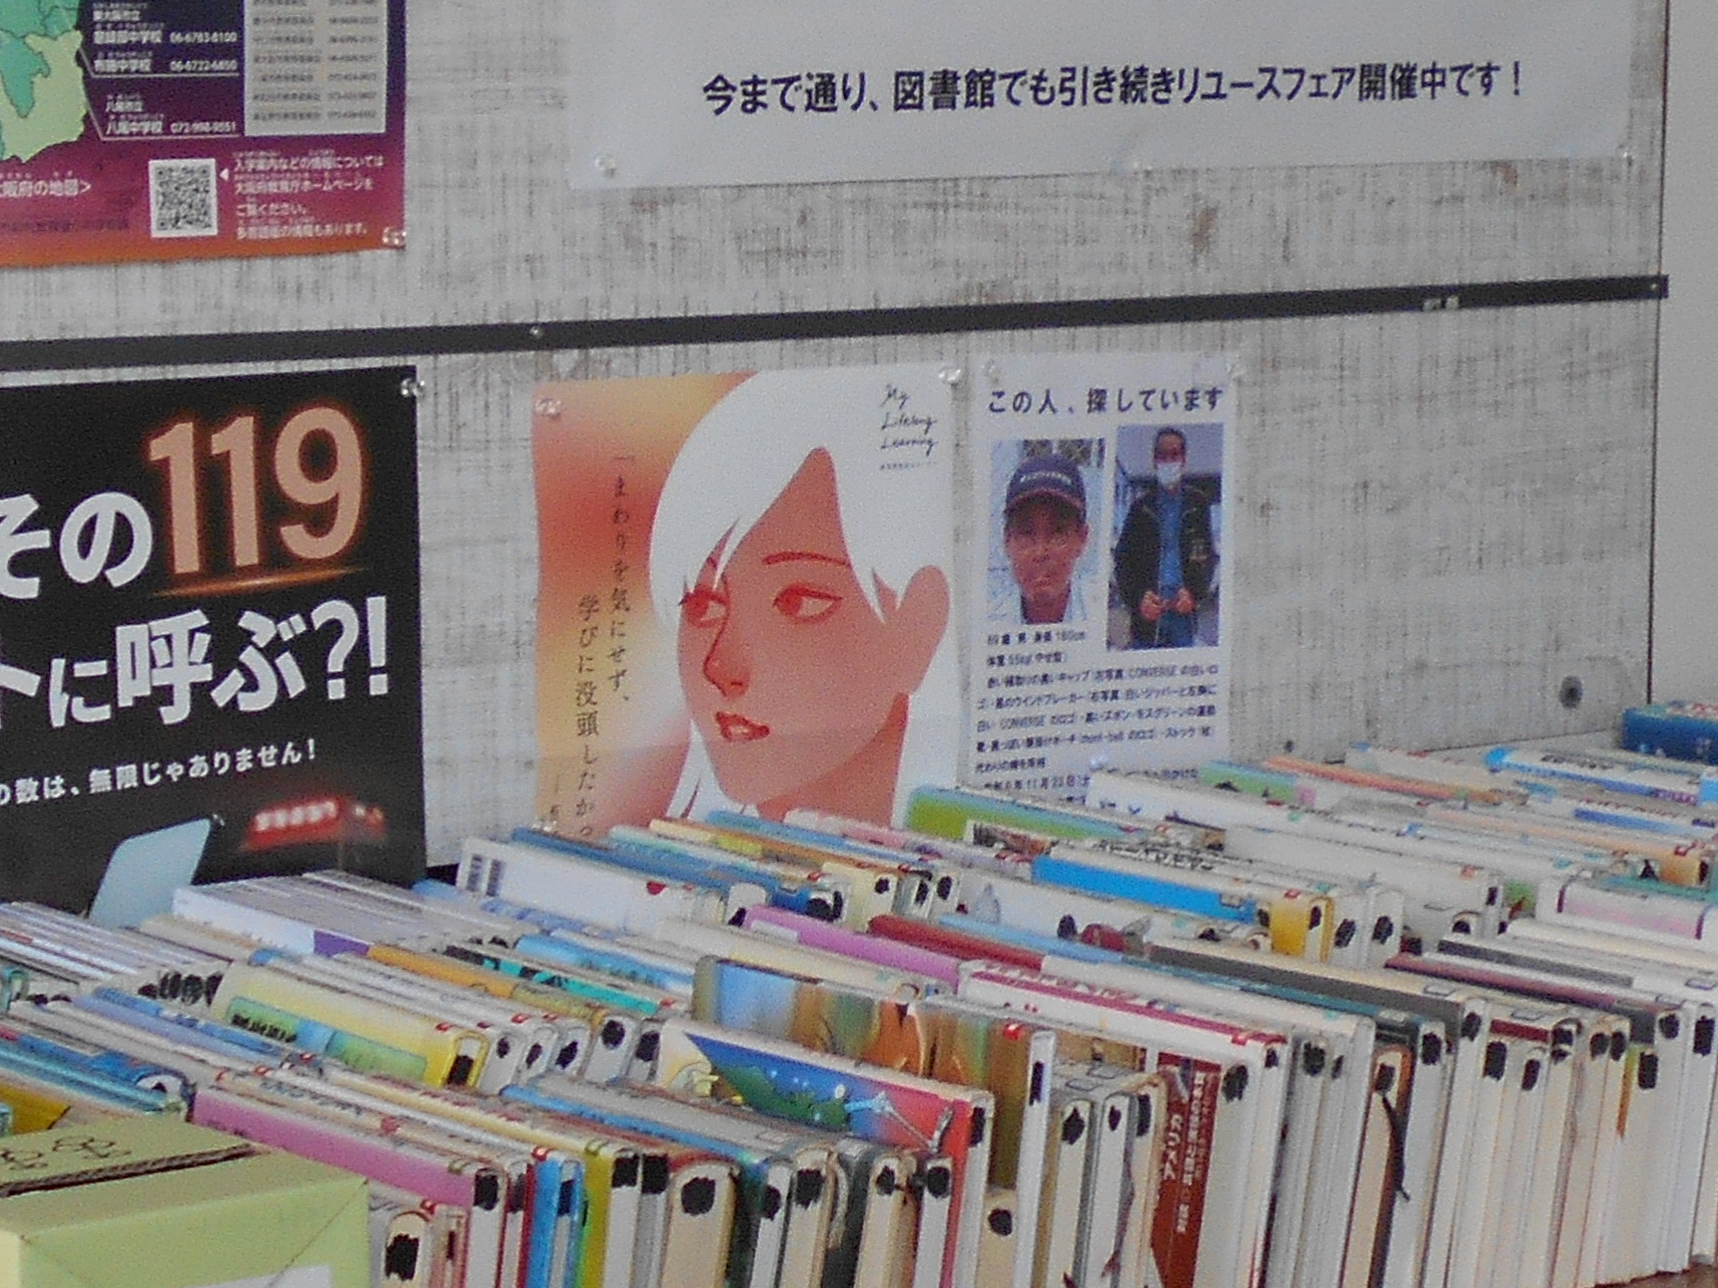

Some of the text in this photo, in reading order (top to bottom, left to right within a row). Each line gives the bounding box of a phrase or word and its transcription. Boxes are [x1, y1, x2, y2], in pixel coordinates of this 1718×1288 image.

[701, 60, 1523, 116] 今まで通り、図書館でも引き続きリユースフェア開催中です！
[988, 387, 1224, 415] この人、探しています
